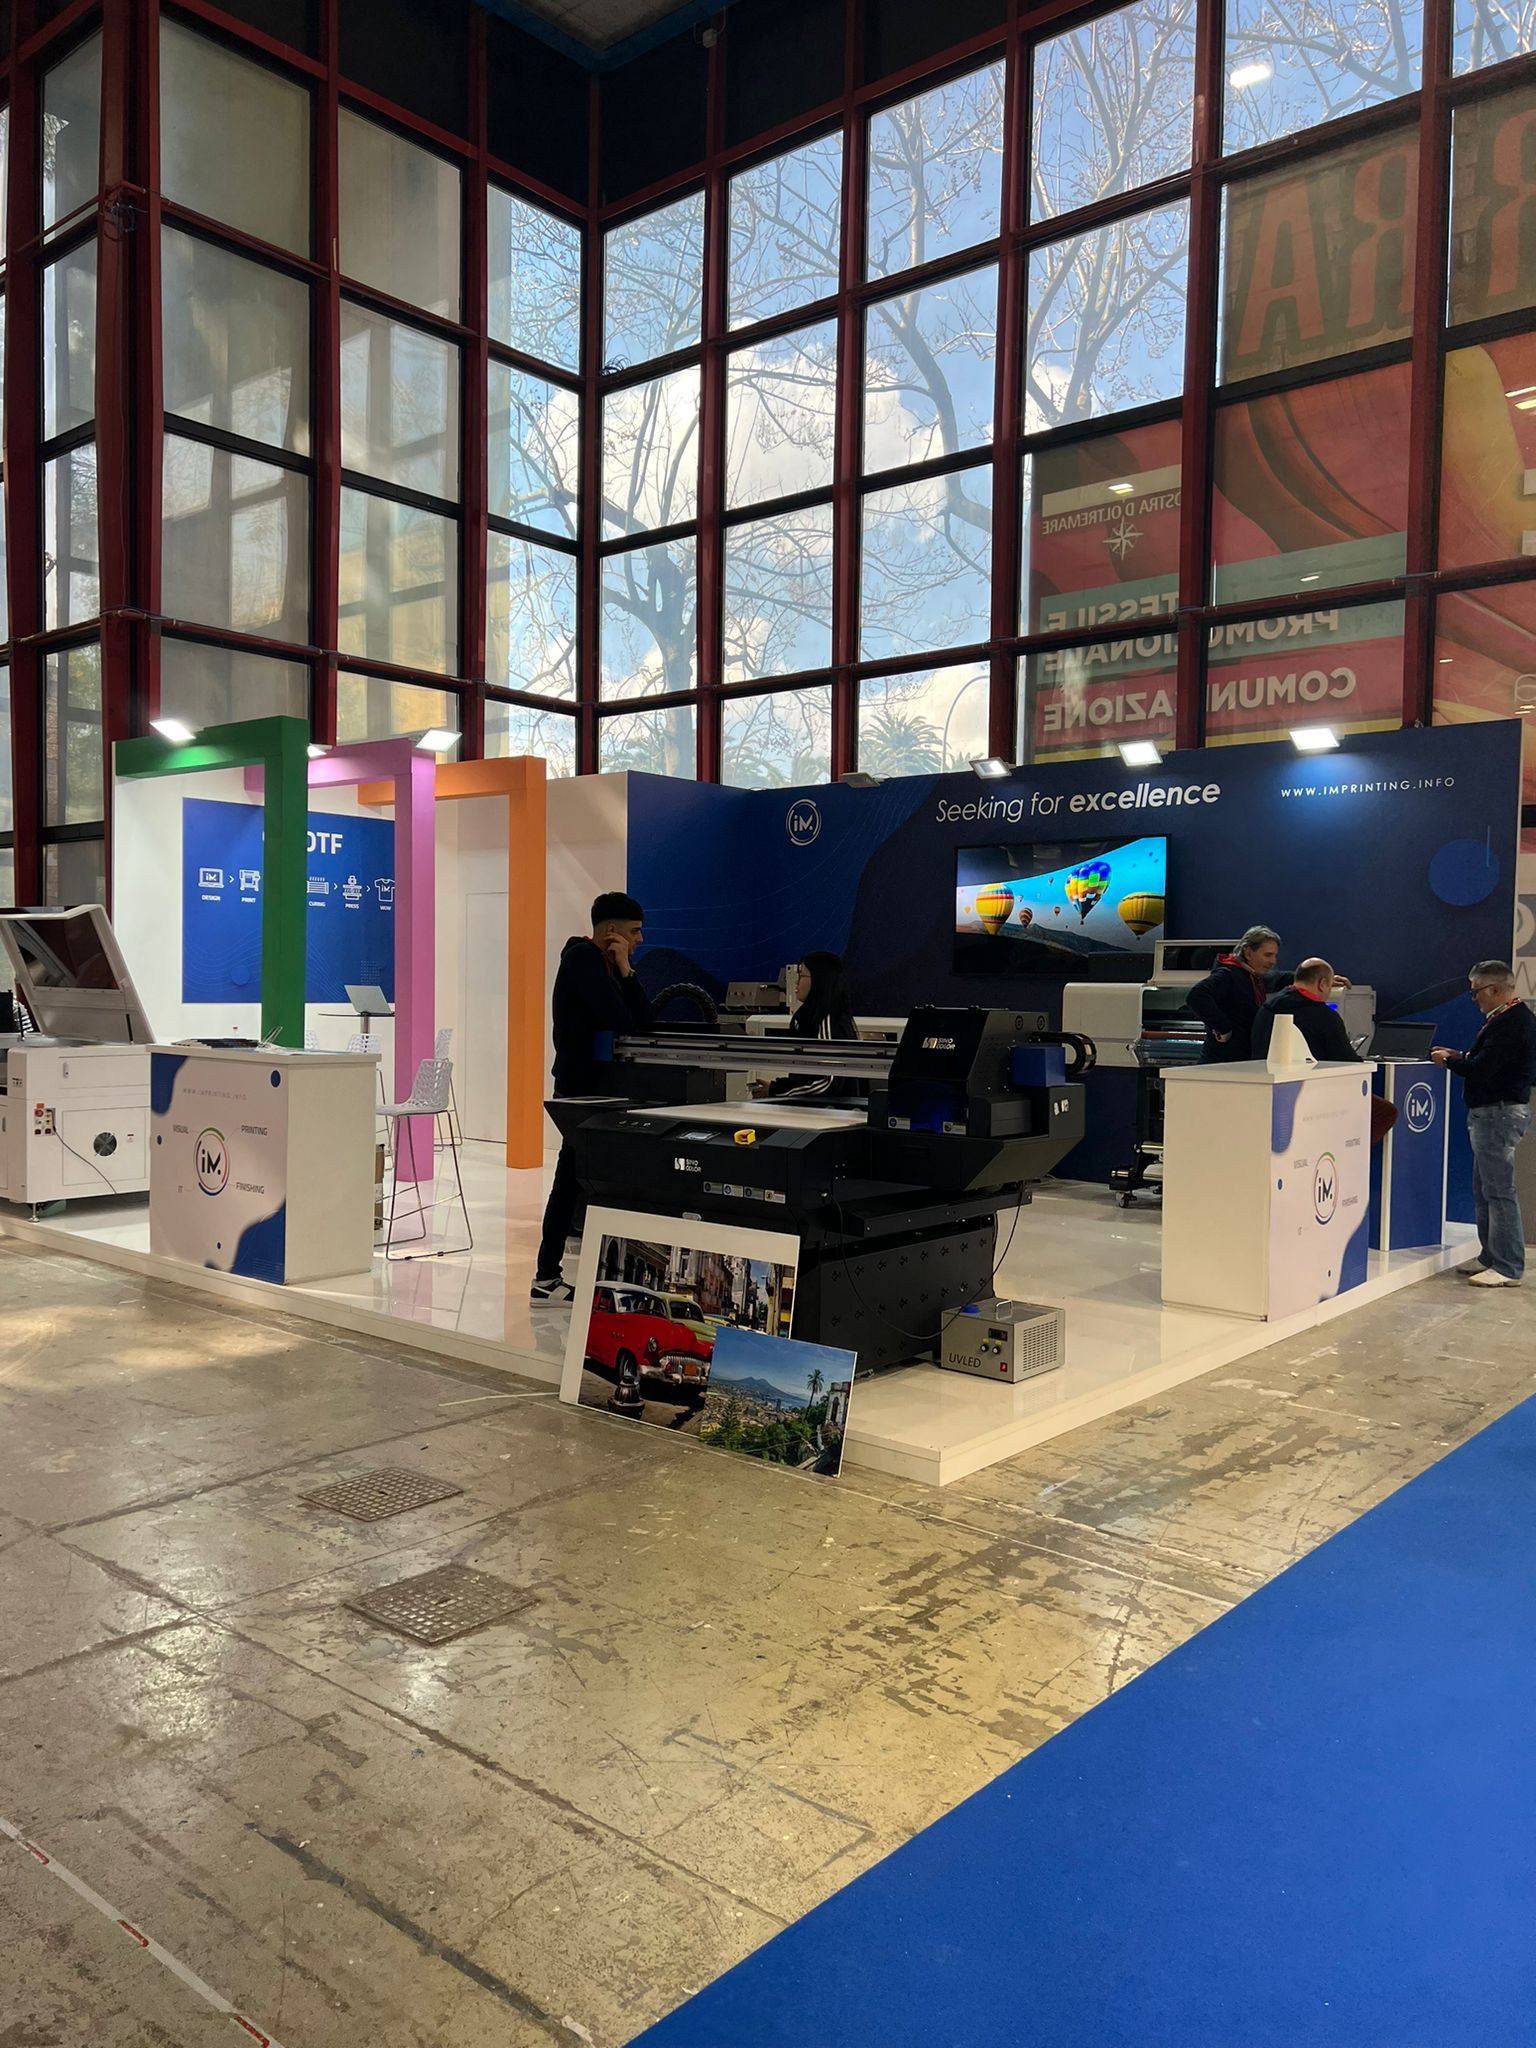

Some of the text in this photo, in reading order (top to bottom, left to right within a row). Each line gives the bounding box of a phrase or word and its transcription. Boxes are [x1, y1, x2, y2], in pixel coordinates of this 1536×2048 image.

[1280, 776, 1456, 798] WWW.IMPRINTING.INFO
[936, 783, 1221, 823] Seeking for excellence
[201, 894, 221, 902] DESIGN
[241, 1124, 269, 1137] PRINTING
[236, 1182, 265, 1195] FINISHING
[948, 1352, 982, 1368] UVLED
